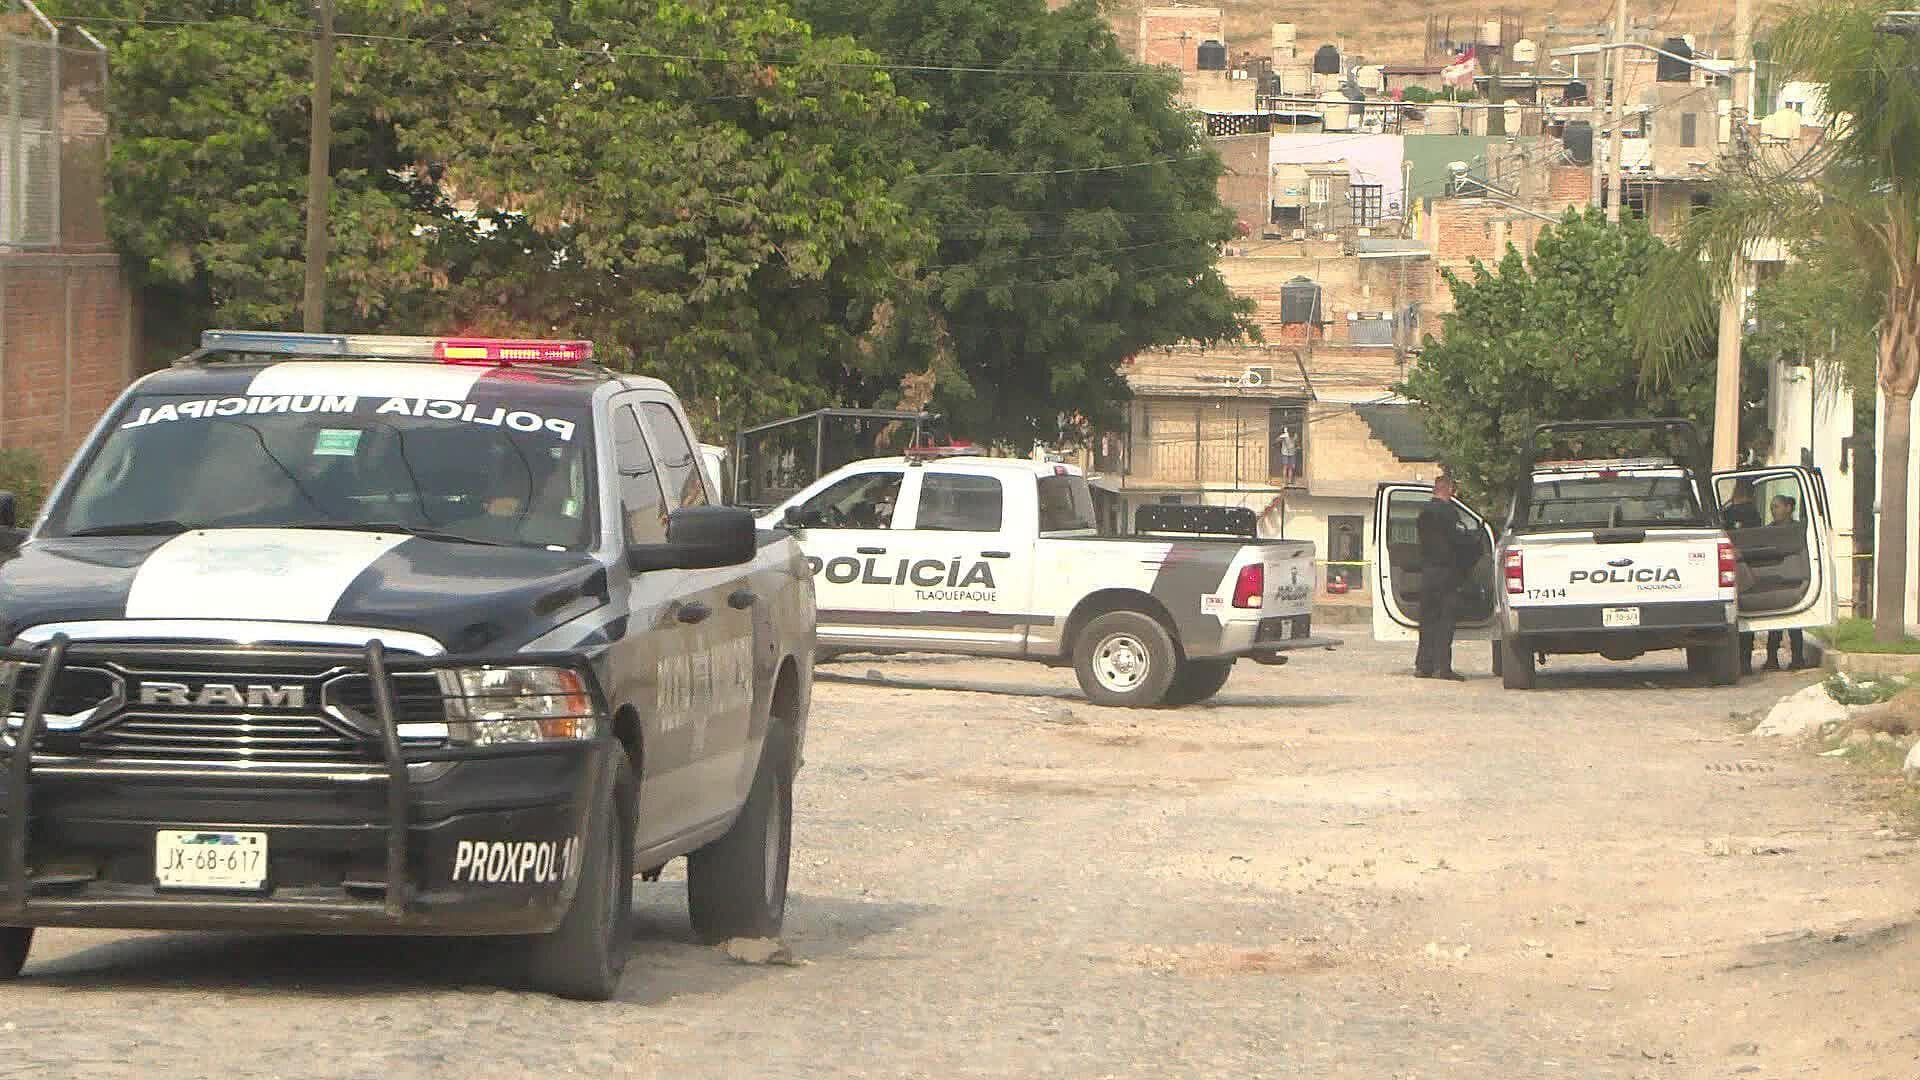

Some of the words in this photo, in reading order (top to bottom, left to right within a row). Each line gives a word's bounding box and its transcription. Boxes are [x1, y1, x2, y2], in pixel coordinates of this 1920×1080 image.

[805, 555, 996, 588] POLICÍA
[915, 590, 997, 602] TLAQUEPAQUE
[1527, 588, 1567, 599] 17414
[140, 681, 304, 708] RAM
[163, 848, 260, 871] JX-68-617
[453, 840, 558, 882] PROXPOL
